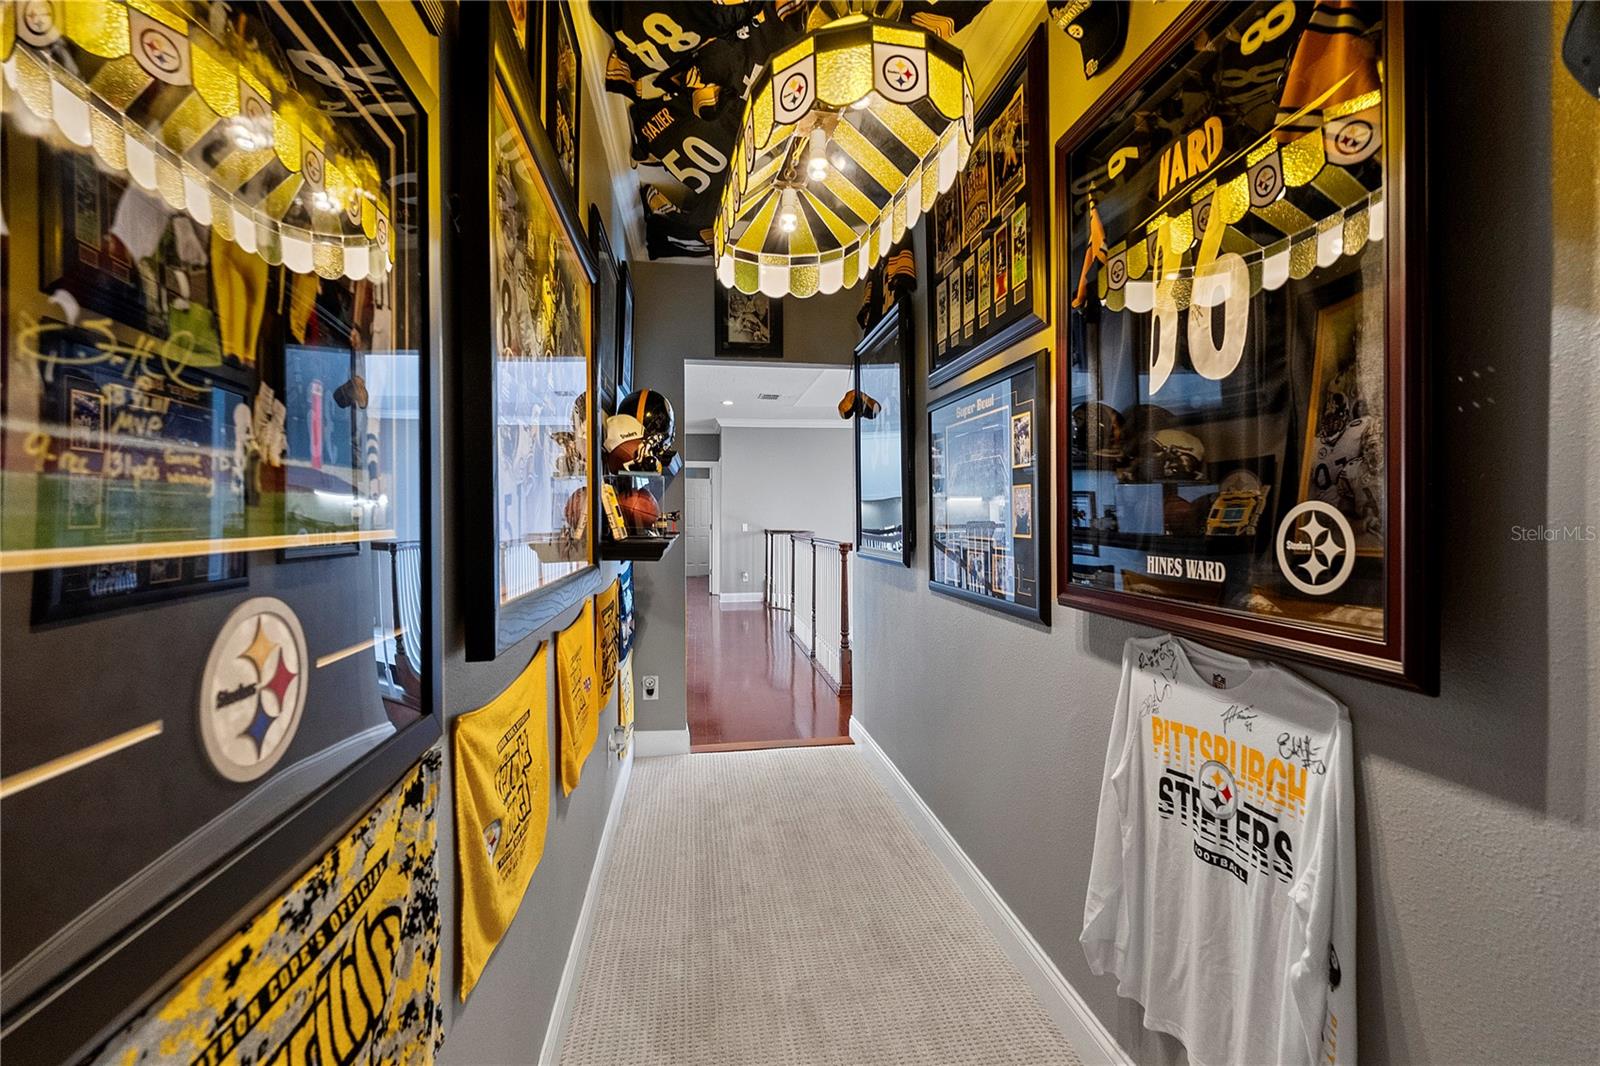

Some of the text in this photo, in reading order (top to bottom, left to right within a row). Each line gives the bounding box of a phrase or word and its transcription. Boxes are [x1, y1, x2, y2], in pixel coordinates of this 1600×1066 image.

[662, 136, 728, 194] 50
[110, 411, 163, 435] MVP
[954, 393, 995, 419] Super Bowl
[1146, 555, 1226, 583] HINES WARD
[1151, 715, 1308, 820] PITTSBURGH
[267, 930, 327, 1004] COPE'S
[329, 858, 388, 932] OFFICIAL
